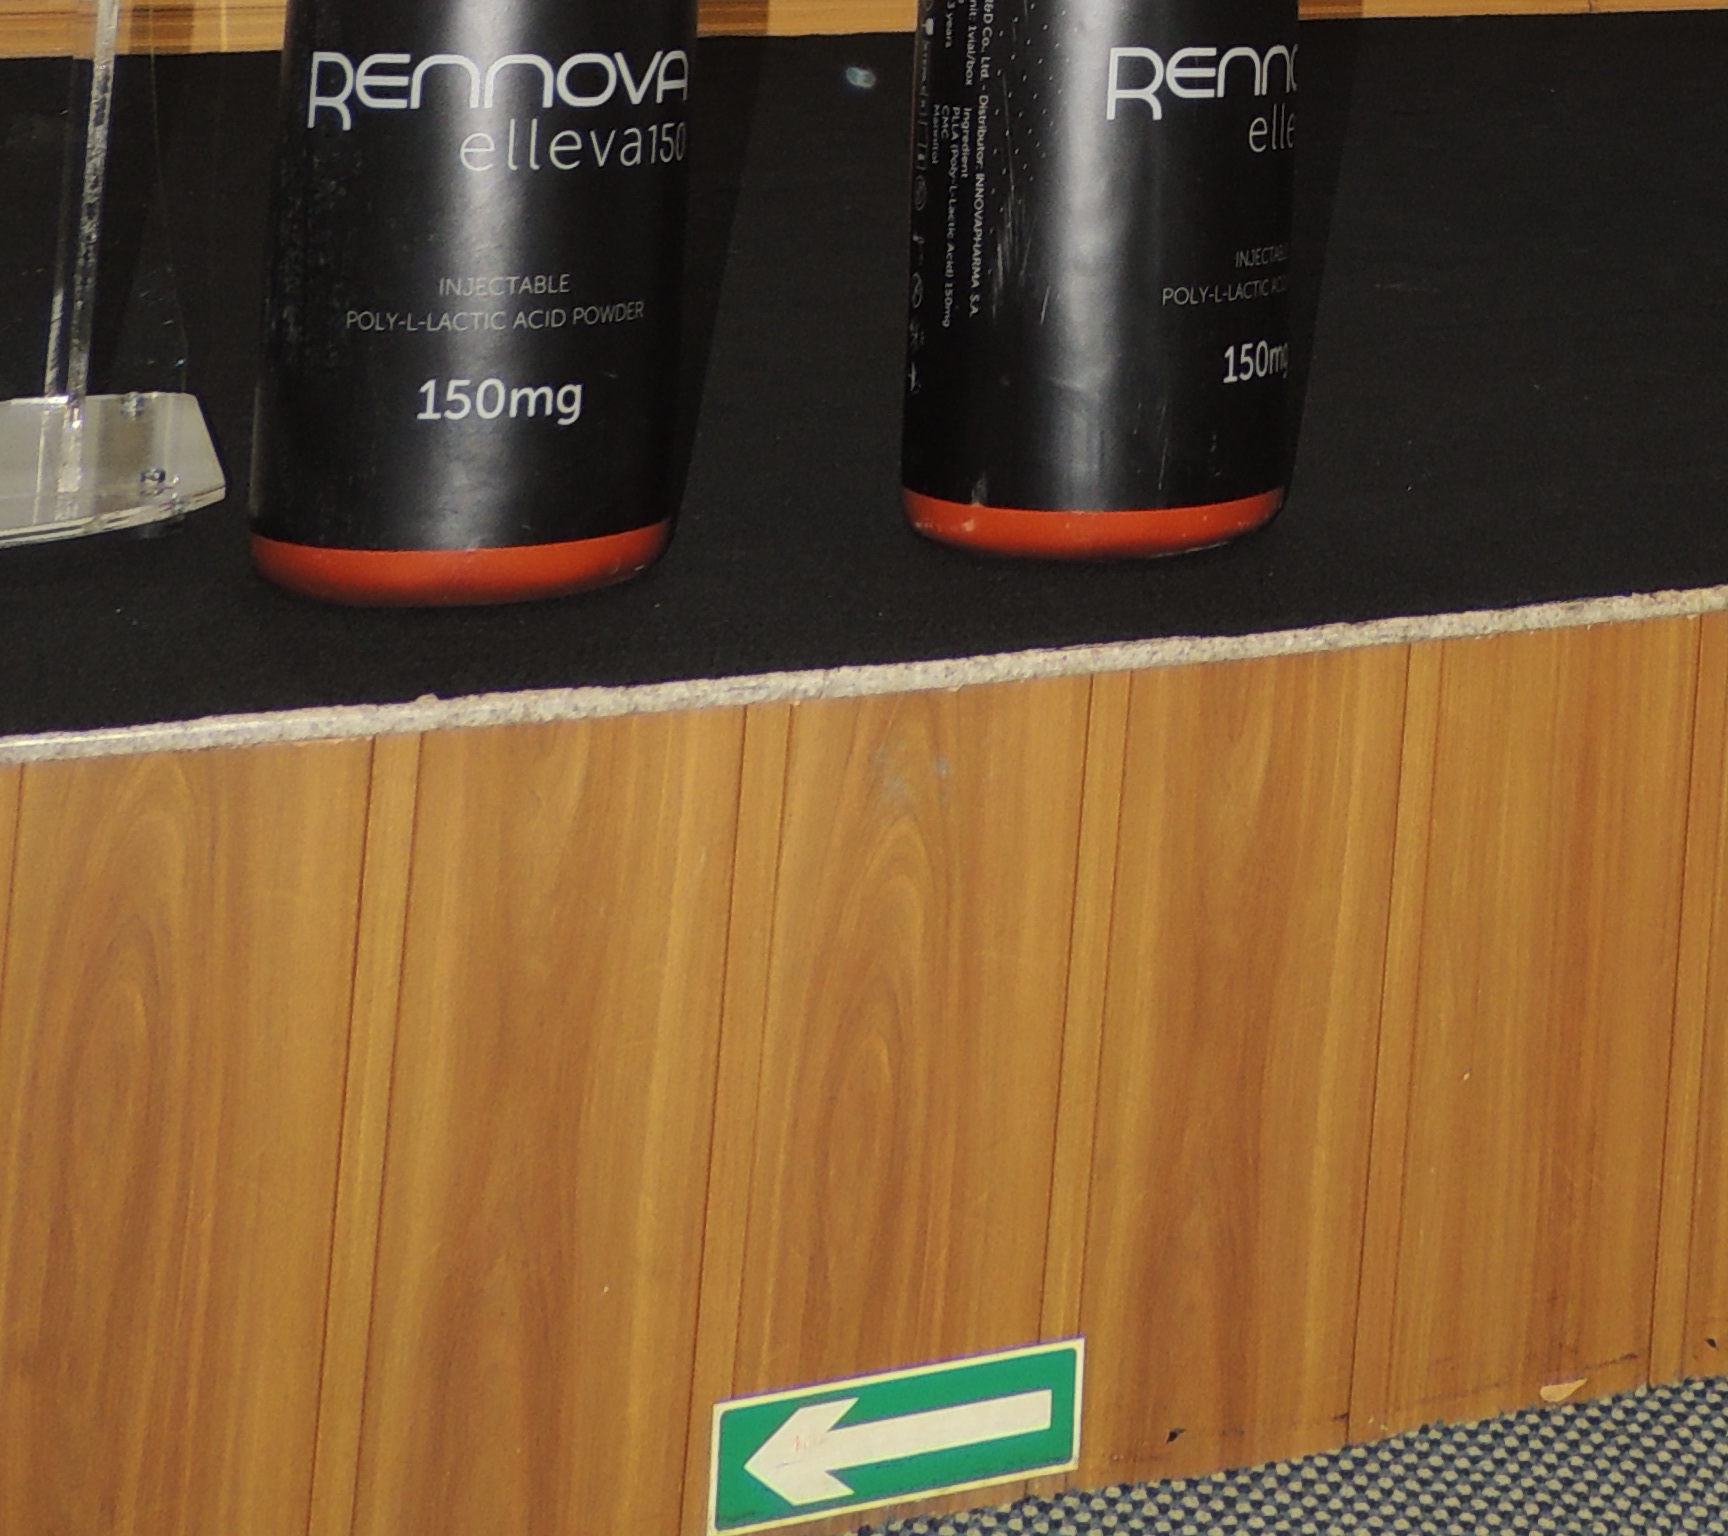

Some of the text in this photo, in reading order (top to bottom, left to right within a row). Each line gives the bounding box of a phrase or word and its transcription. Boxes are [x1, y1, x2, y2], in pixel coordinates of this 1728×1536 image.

[307, 50, 689, 131] RENNOVA
[941, 105, 949, 139] CMC
[950, 107, 960, 140] PLLA
[971, 173, 984, 288] INNOVAPHARMA
[439, 274, 570, 296] INJECTABLE
[1162, 278, 1270, 306] POLY-L-LACTIC
[346, 301, 645, 332] POLY-L-LACTIC ACID POWDER
[416, 378, 583, 425] 150mg
